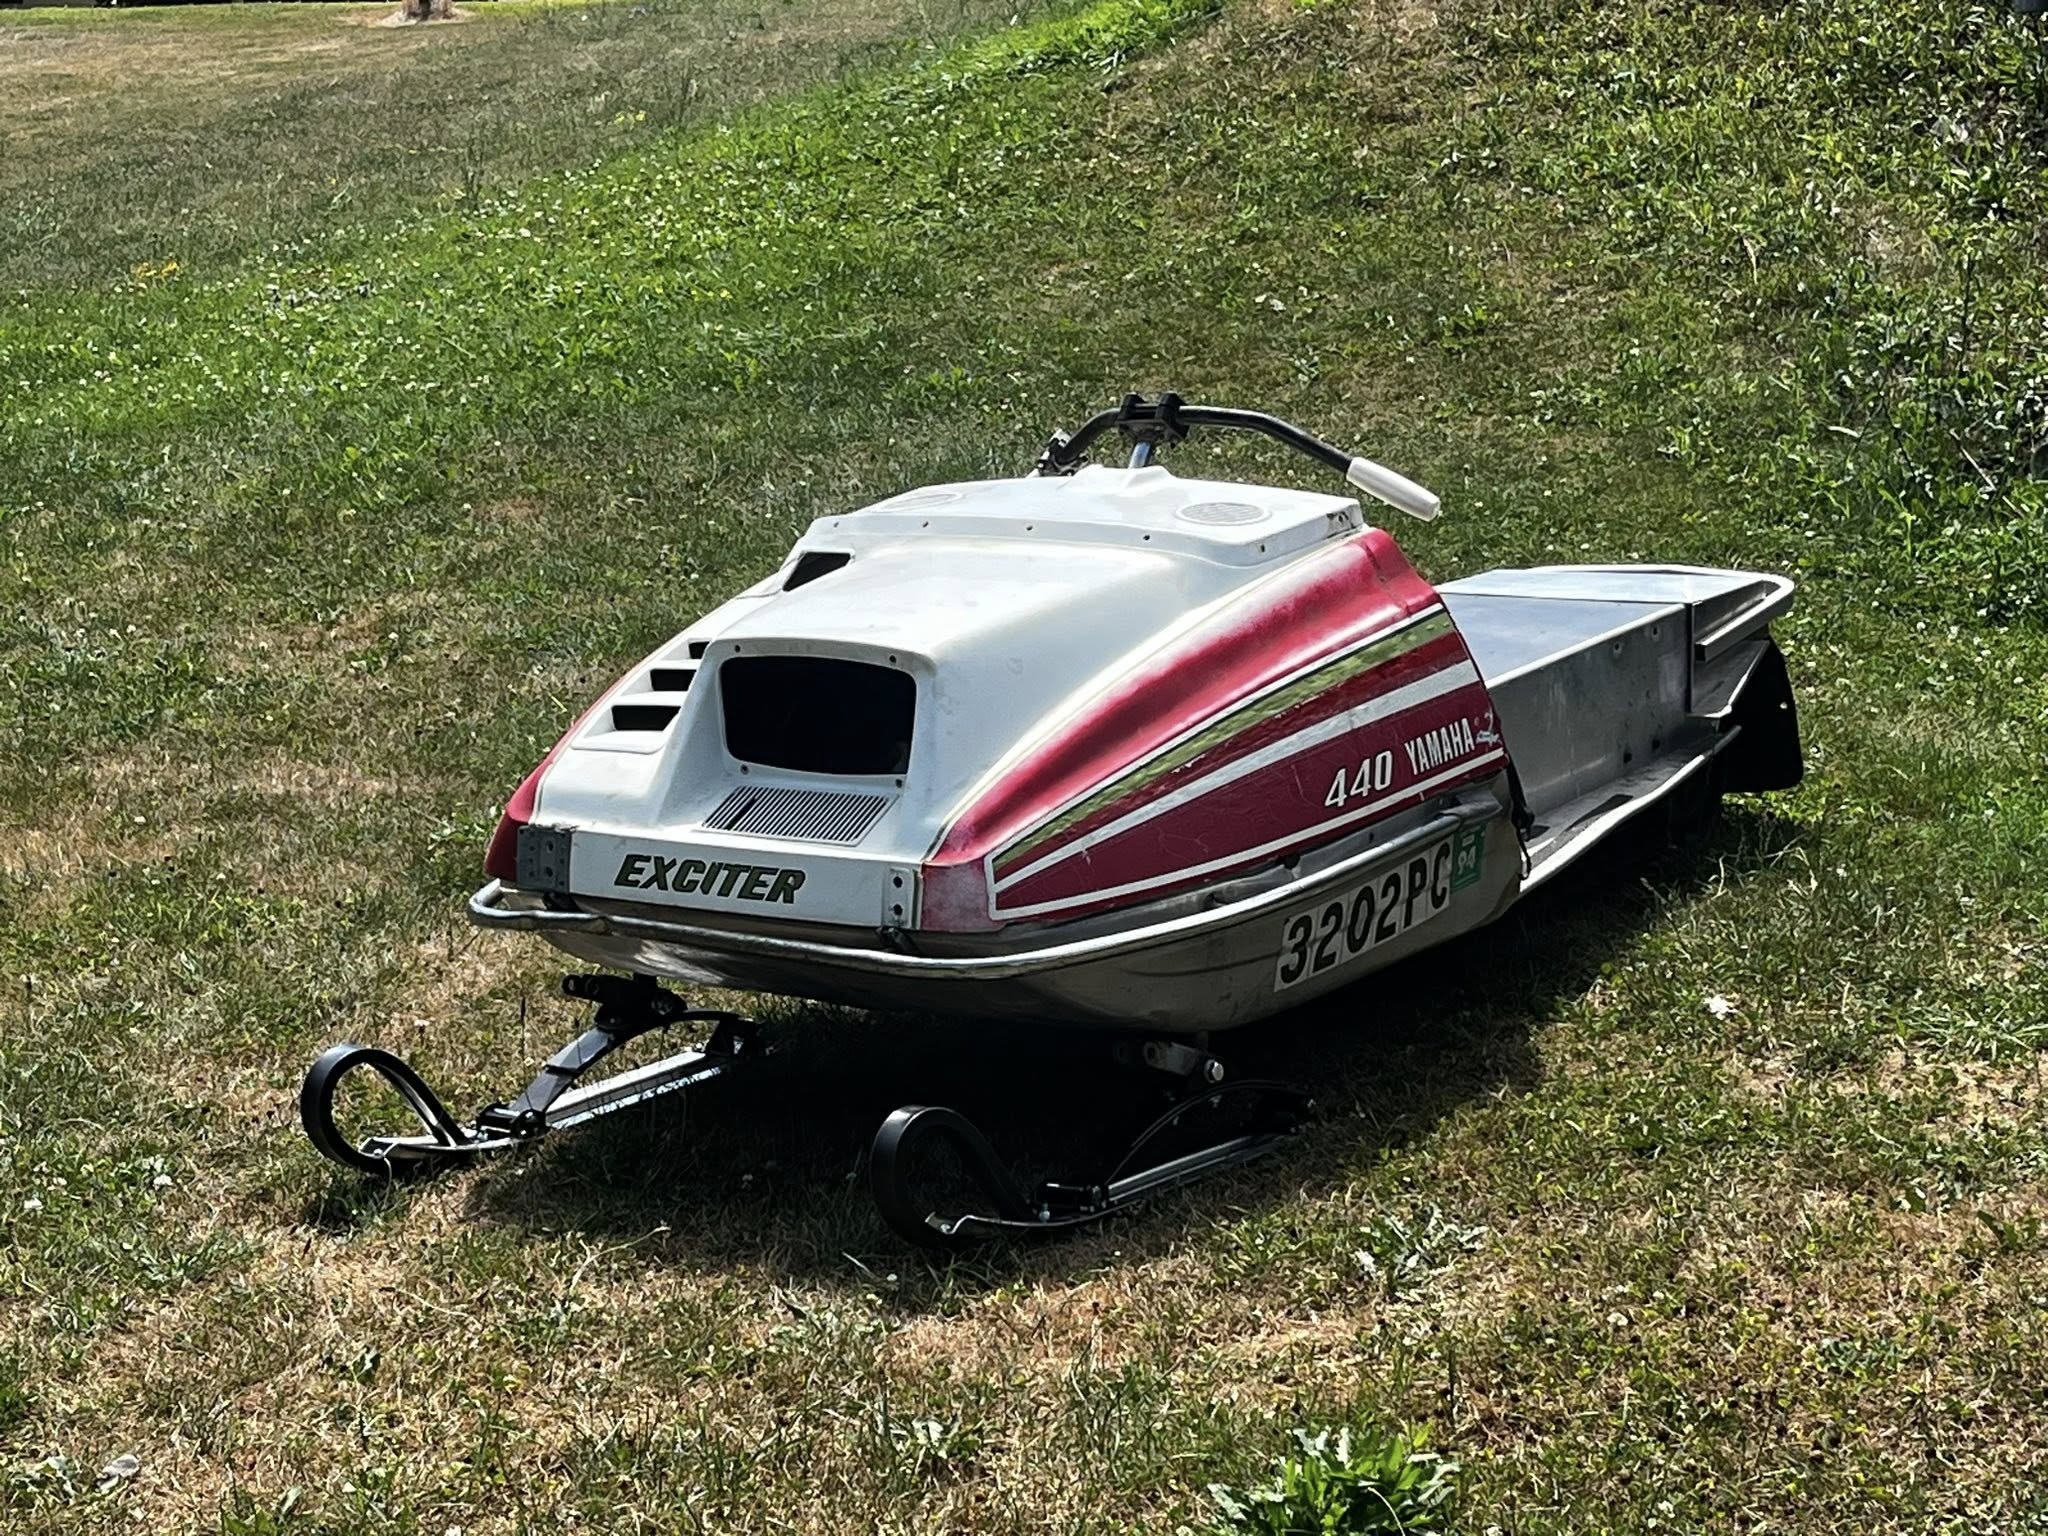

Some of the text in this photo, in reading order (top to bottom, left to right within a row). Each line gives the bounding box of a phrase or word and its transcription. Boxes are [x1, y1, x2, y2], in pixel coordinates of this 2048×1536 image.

[1324, 717, 1476, 808] 440 YAMAHA
[613, 852, 808, 905] EXCITER
[1457, 845, 1477, 875] 94
[1279, 842, 1450, 984] 3202PC
